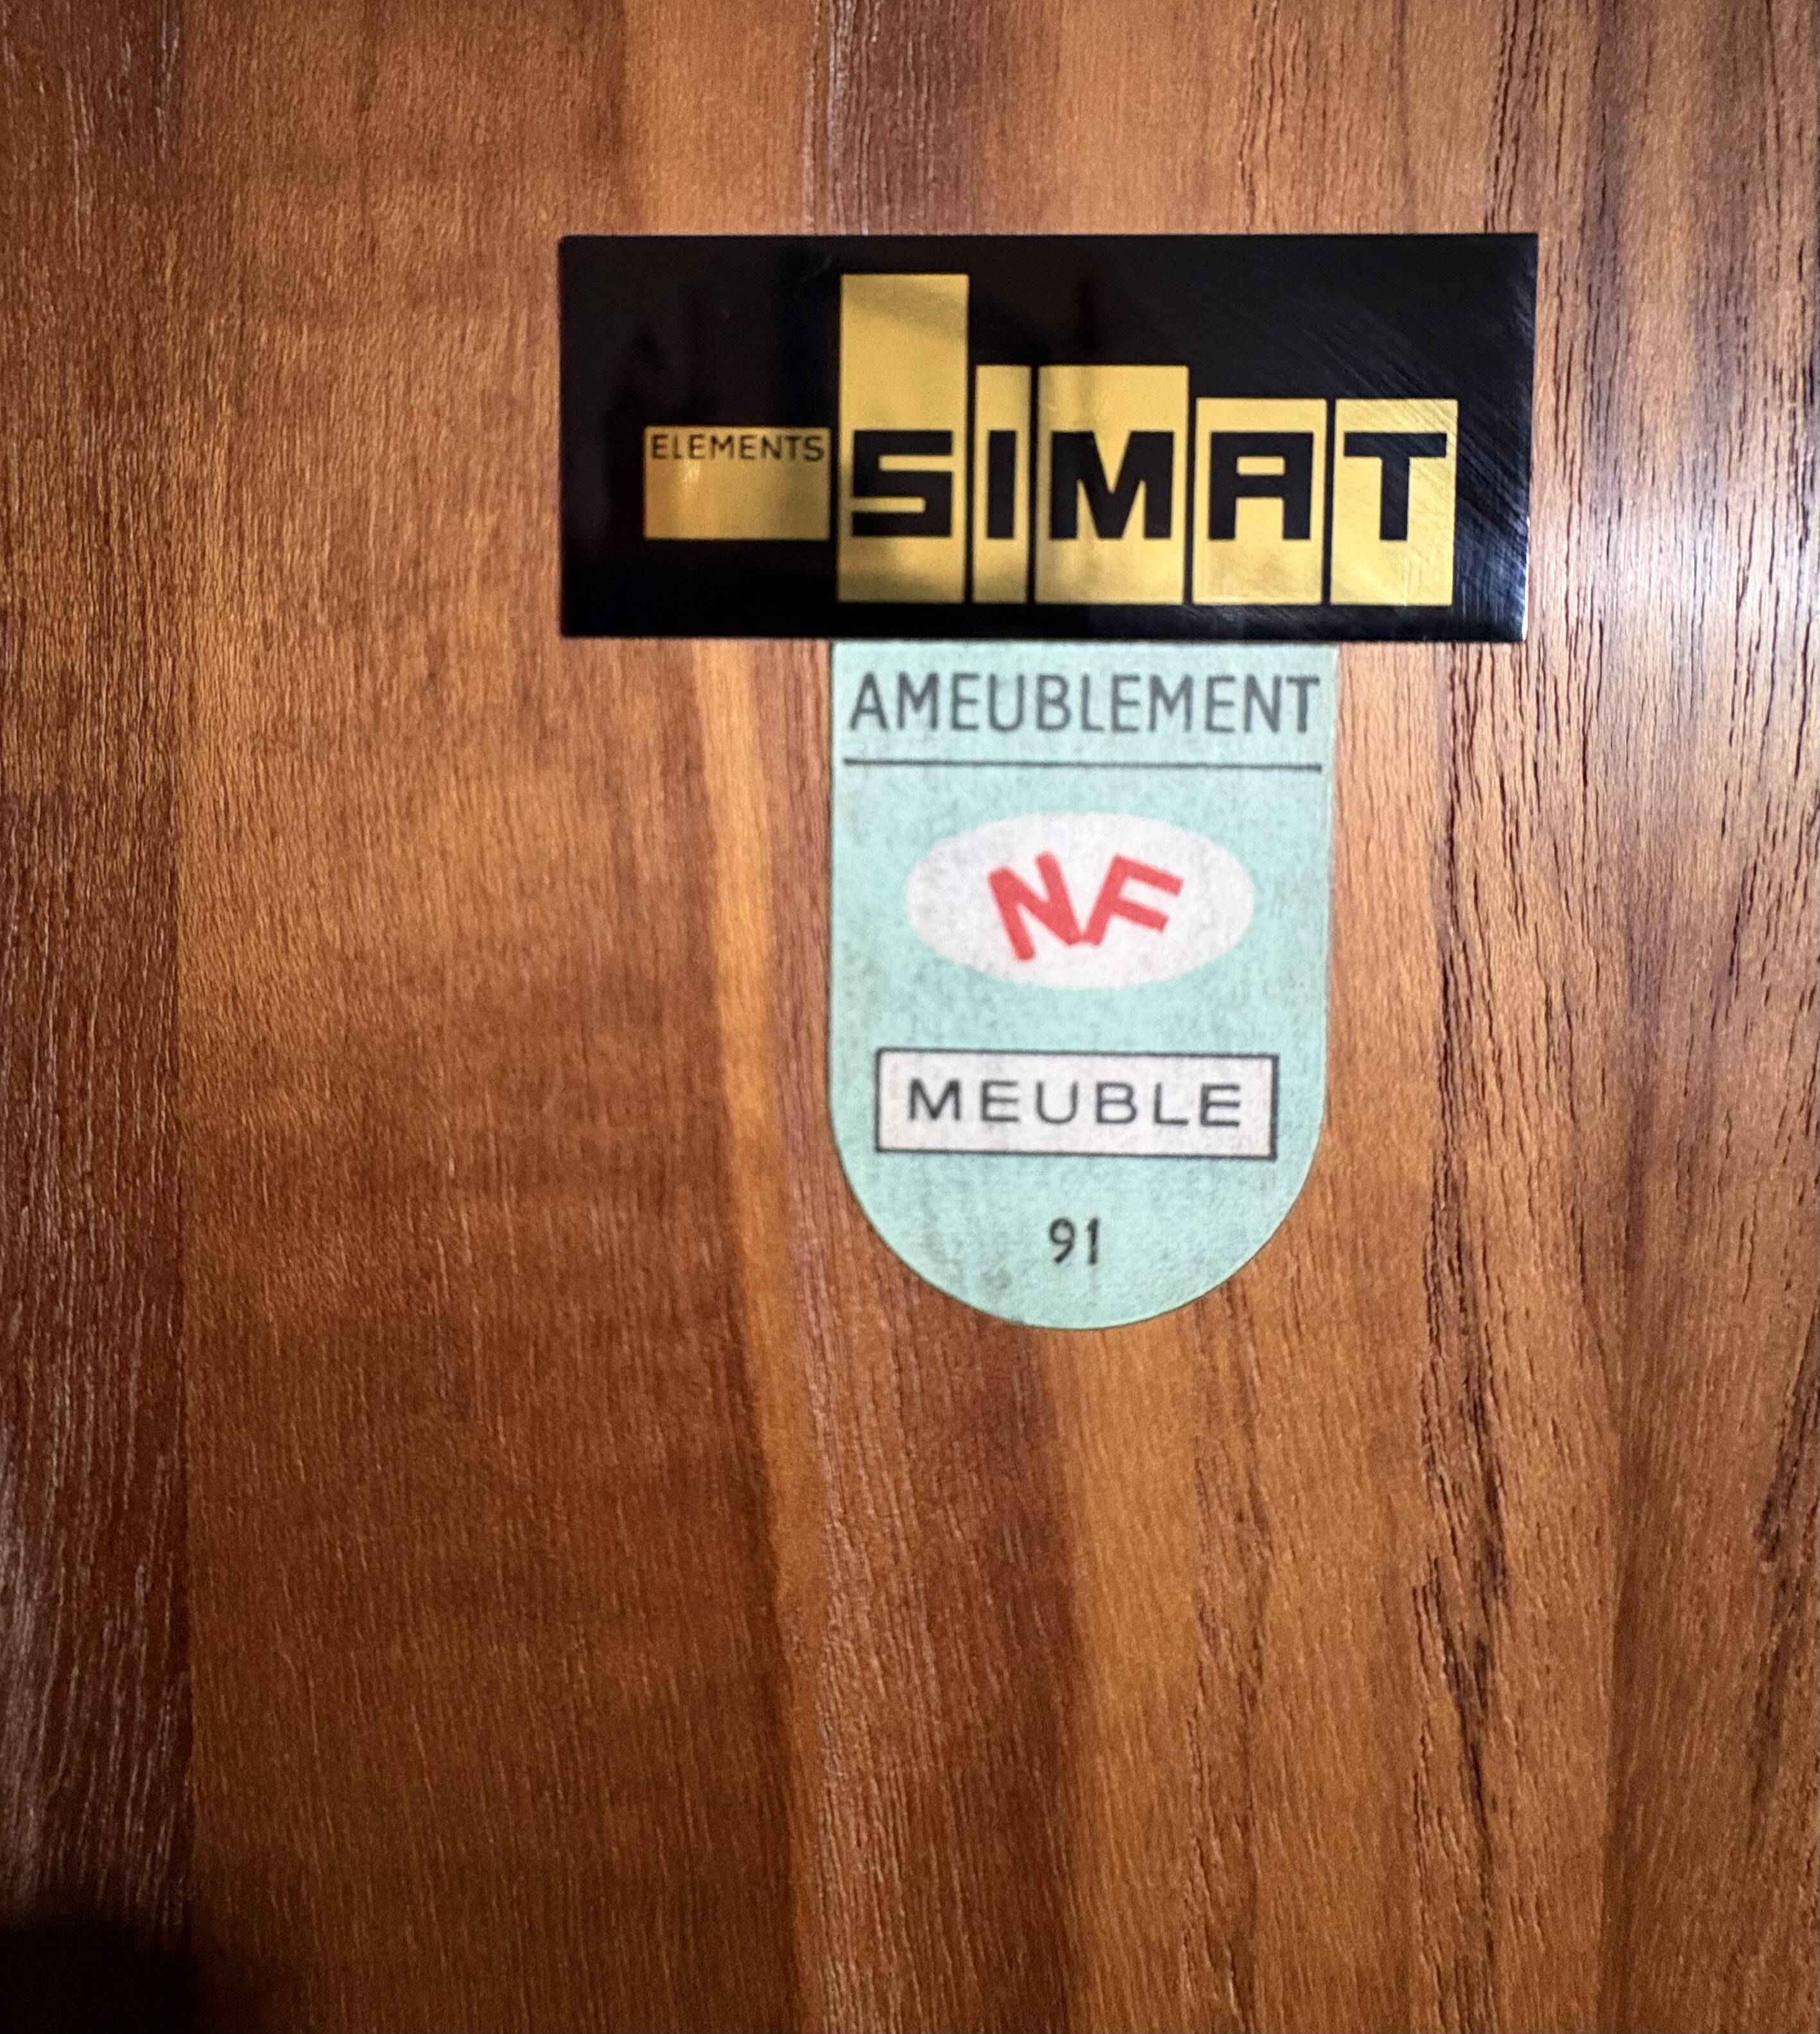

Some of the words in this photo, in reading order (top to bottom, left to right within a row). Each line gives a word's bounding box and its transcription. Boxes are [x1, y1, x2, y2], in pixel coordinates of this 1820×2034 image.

[651, 434, 826, 461] ELEMENTS
[851, 429, 1448, 541] SIMAT
[849, 671, 1321, 734] AMEUBLEMENT
[987, 851, 1184, 961] NF
[908, 1078, 1241, 1128] MEUBLE
[1048, 1217, 1100, 1265] 91
